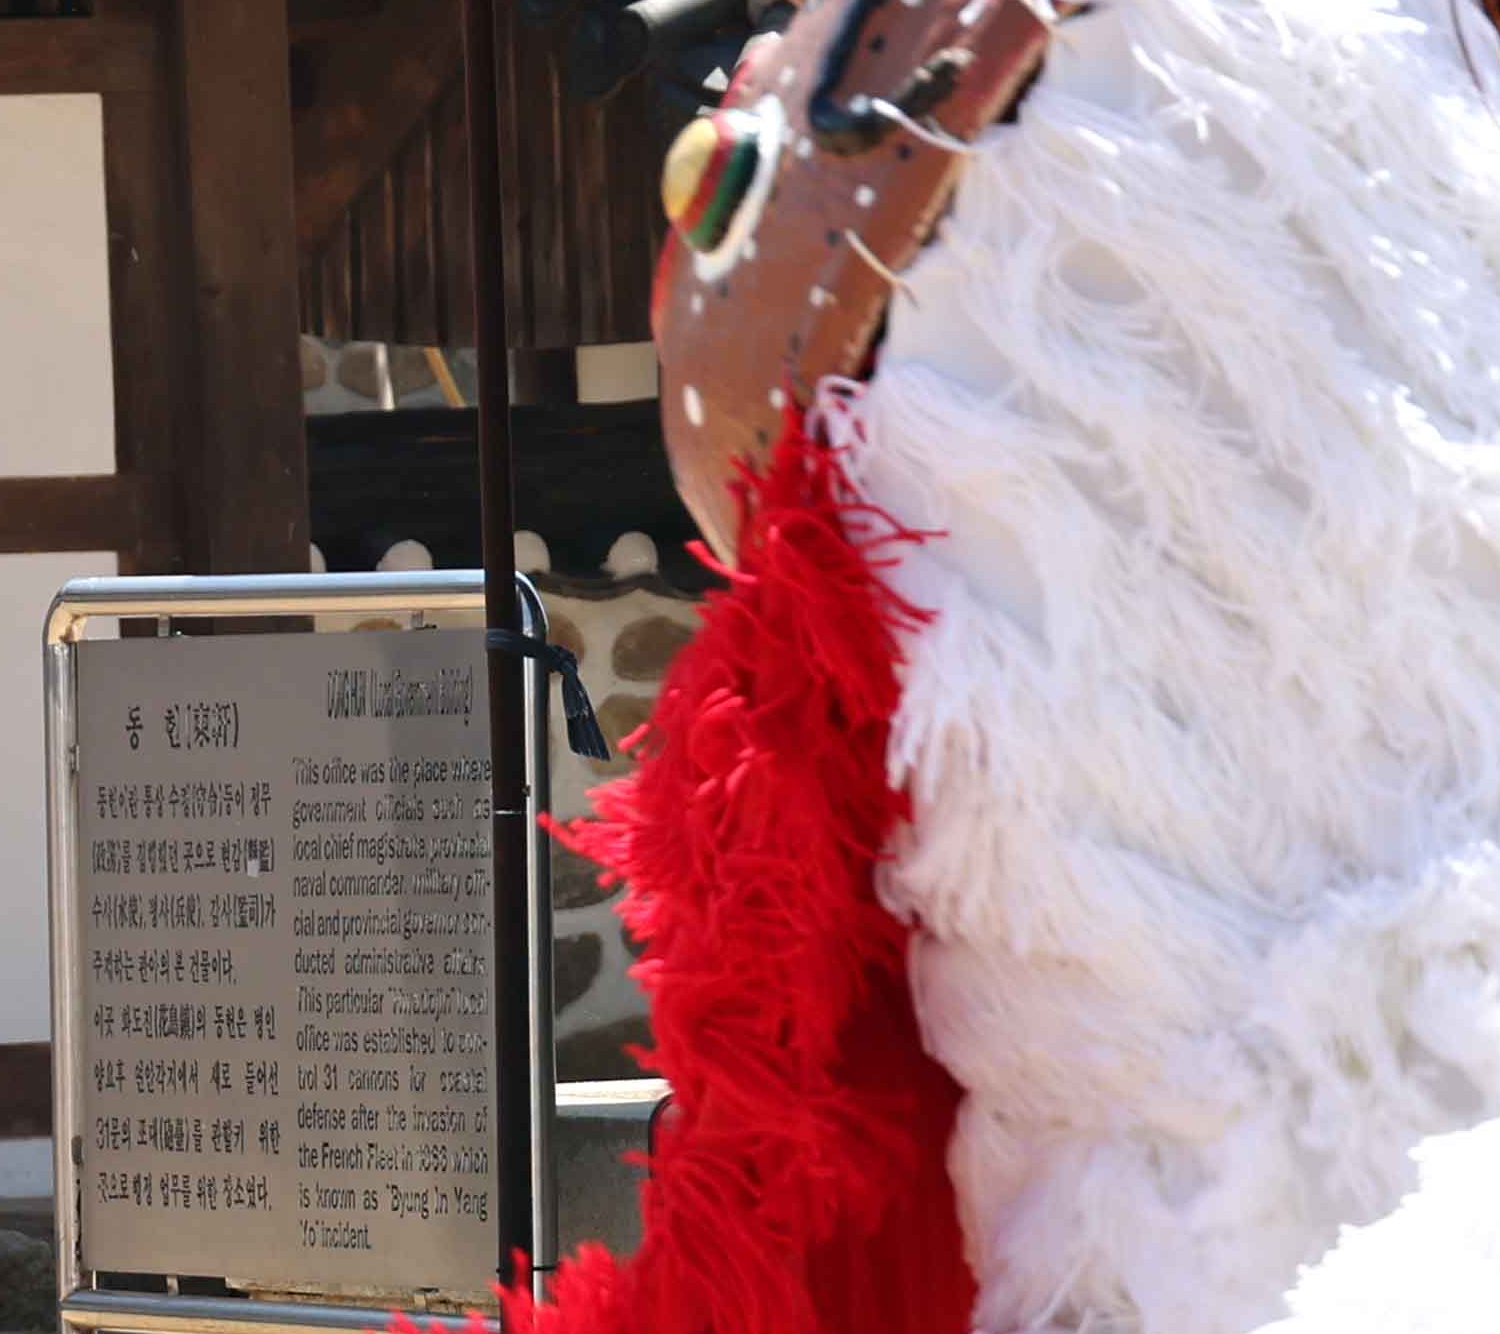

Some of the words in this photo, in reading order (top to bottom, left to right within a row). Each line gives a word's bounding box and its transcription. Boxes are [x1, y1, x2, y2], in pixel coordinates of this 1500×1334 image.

[125, 705, 144, 751] 동
[292, 758, 319, 785] This
[322, 757, 356, 785] office
[361, 762, 385, 784] was
[389, 757, 408, 784] the
[413, 756, 447, 789] place
[452, 756, 491, 783] where
[292, 797, 367, 828] government
[376, 793, 424, 821] officials
[432, 792, 464, 819] such
[473, 798, 490, 819] as
[293, 833, 321, 860] local
[324, 833, 354, 859] chief
[293, 869, 327, 897] naval
[413, 868, 459, 902] military
[294, 908, 315, 936] cial
[318, 910, 340, 935] and
[403, 910, 458, 940] governor
[190, 948, 239, 985] 건물이다.
[295, 948, 335, 974] ducted
[344, 948, 433, 974] administrative
[297, 986, 322, 1013] This
[326, 987, 384, 1019] particular
[458, 987, 489, 1015] local
[94, 1004, 114, 1040] 이곳
[254, 1005, 276, 1040] 병인
[296, 1025, 330, 1051] office
[333, 1028, 358, 1051] was
[363, 1027, 435, 1054] established
[441, 1027, 454, 1052] to
[94, 1060, 126, 1094] 양요후
[210, 1060, 232, 1096] 새로
[245, 1060, 280, 1096] 들어선
[298, 1063, 317, 1091] trol
[324, 1064, 338, 1090] 31
[348, 1068, 399, 1091] cannons
[409, 1064, 426, 1091] for
[440, 1066, 488, 1093] coastal
[297, 1102, 346, 1130] defense
[351, 1103, 379, 1130] after
[387, 1104, 406, 1130] the
[413, 1104, 465, 1134] invasion
[474, 1105, 488, 1133] of
[96, 1116, 131, 1152] 31문의
[258, 1118, 280, 1155] 위한
[298, 1142, 319, 1168] the
[322, 1142, 363, 1169] French
[367, 1143, 398, 1170] Fleet
[402, 1144, 412, 1171] in
[453, 1145, 488, 1174] which
[160, 1173, 192, 1209] 업무를
[197, 1174, 217, 1210] 위한
[224, 1174, 272, 1211] 장소였다.
[299, 1182, 310, 1208] is
[316, 1181, 355, 1210] known
[363, 1188, 378, 1210] as
[435, 1186, 448, 1214] In
[455, 1186, 488, 1221] Yang
